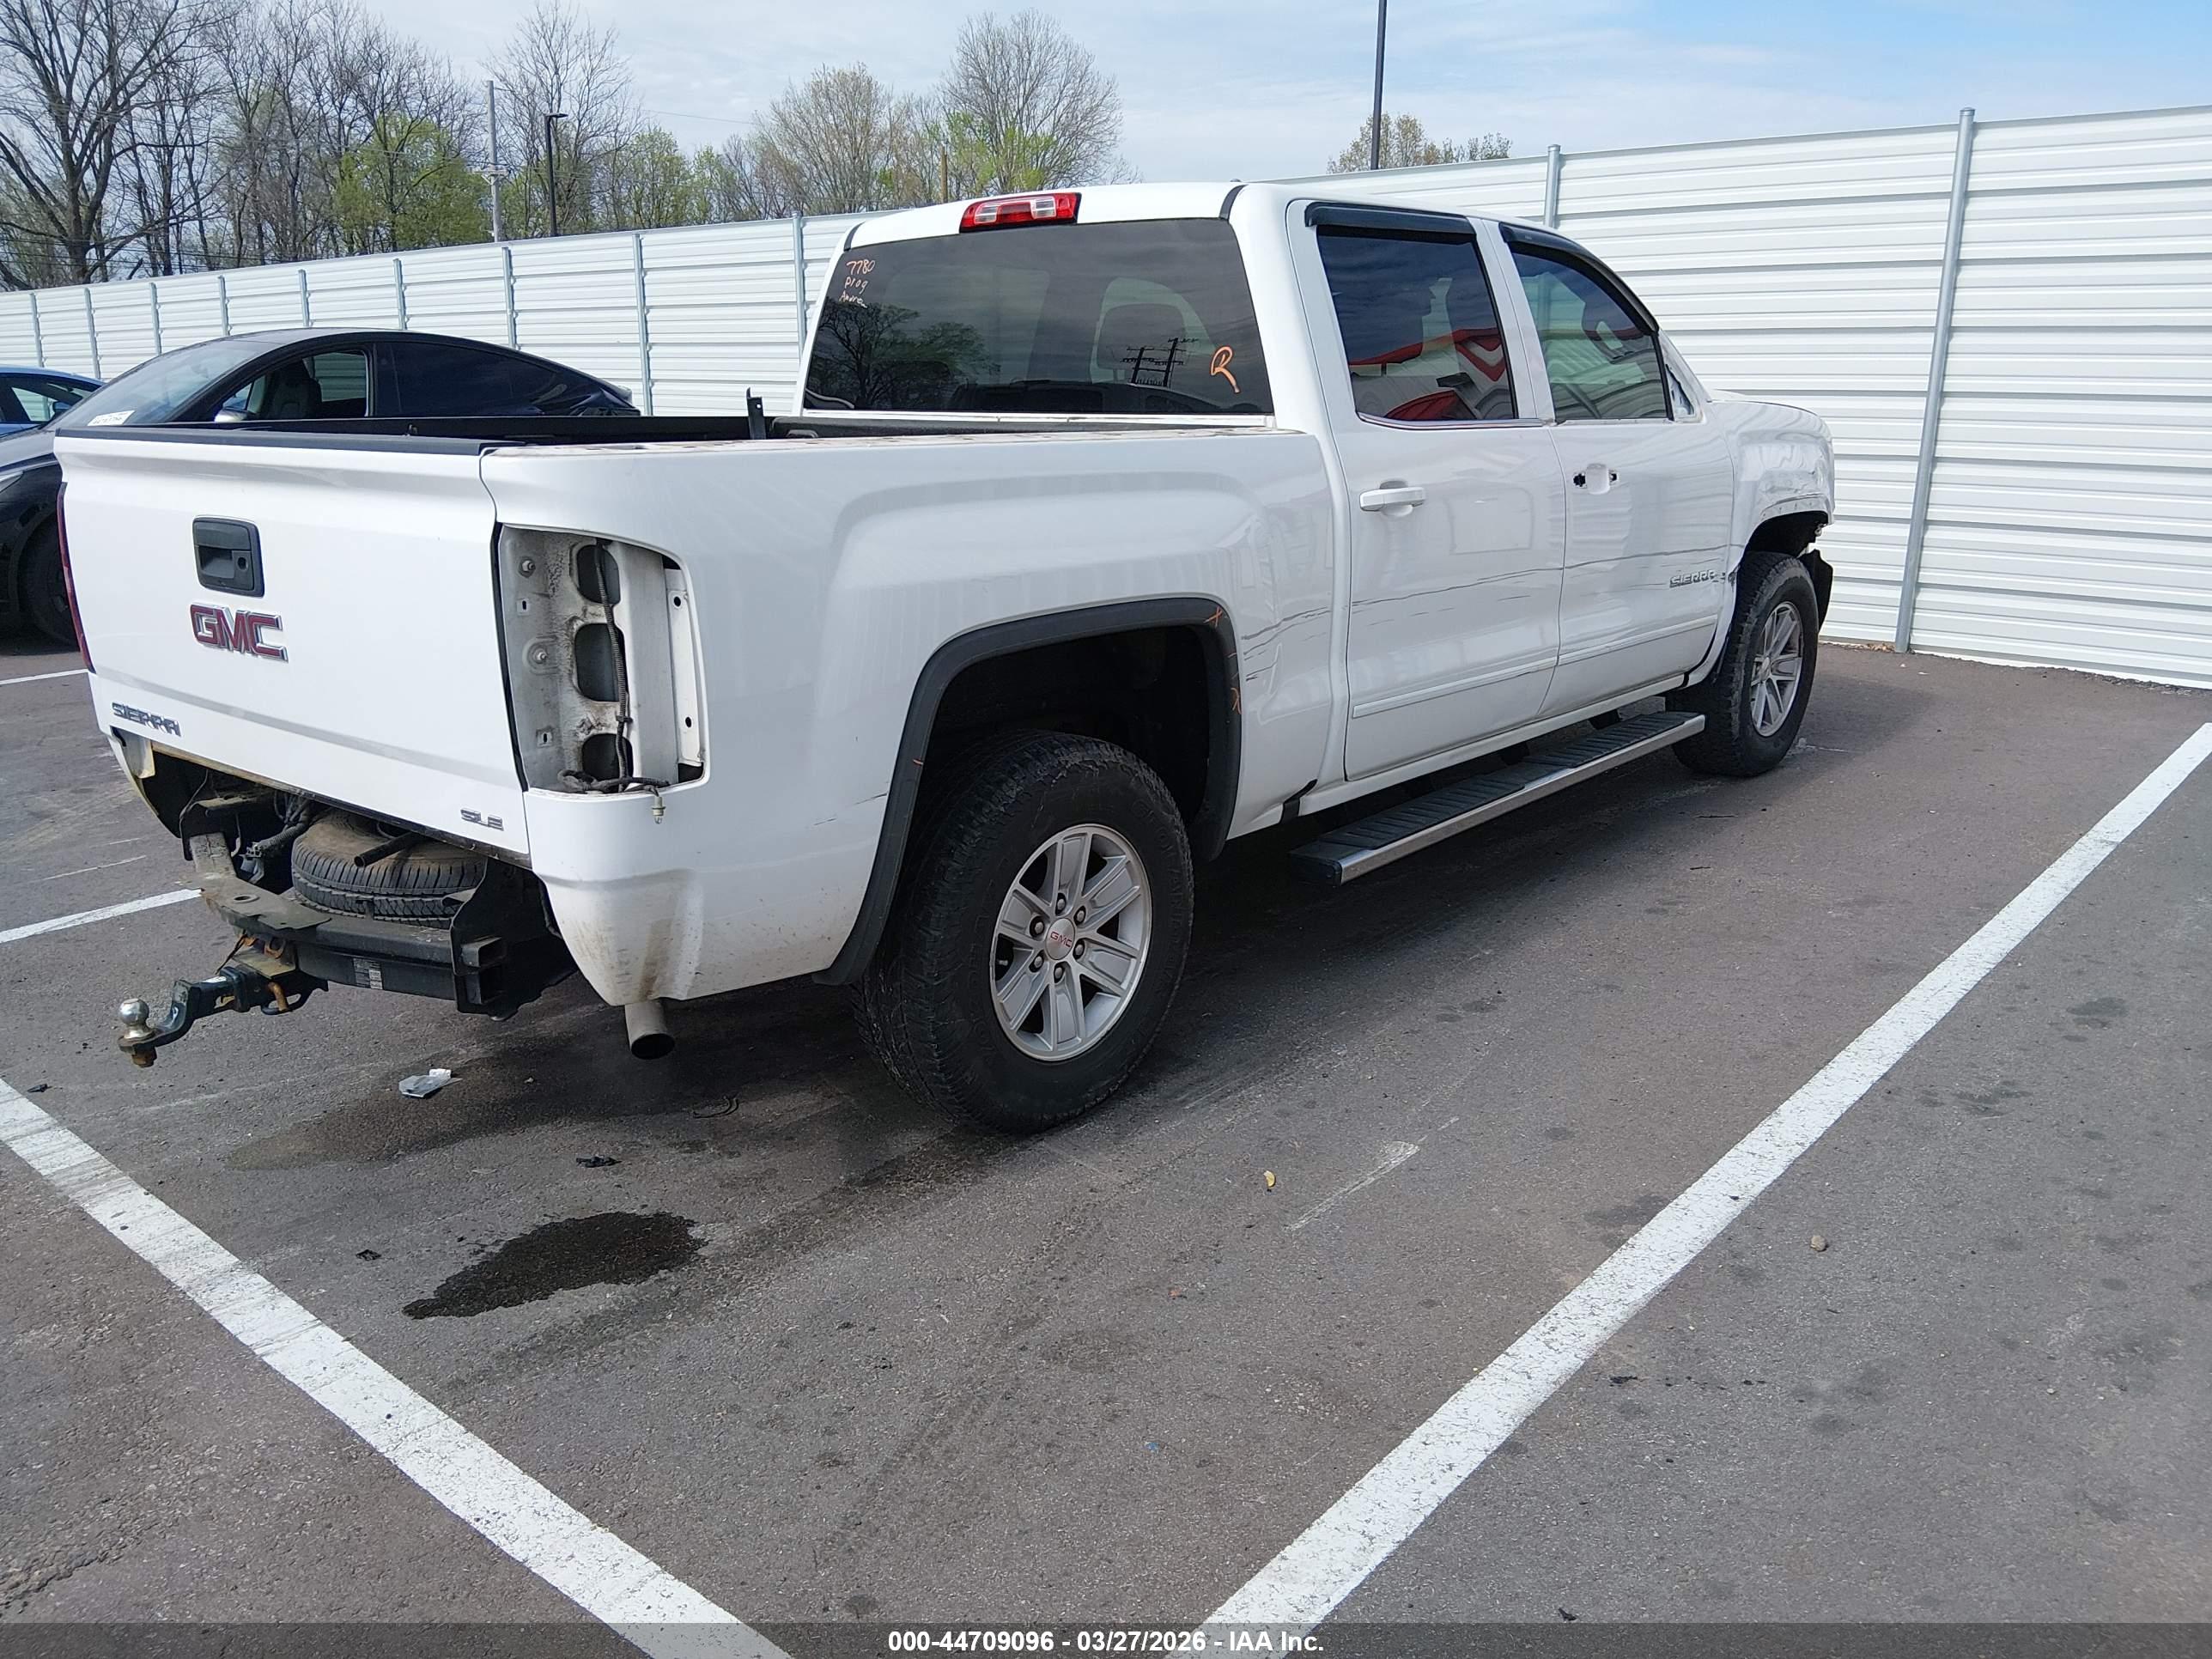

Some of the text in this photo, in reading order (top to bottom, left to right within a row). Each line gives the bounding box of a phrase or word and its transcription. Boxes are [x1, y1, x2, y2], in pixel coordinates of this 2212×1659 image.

[846, 259, 876, 276] 7780
[1210, 346, 1240, 393] R
[190, 602, 289, 664] GMC
[111, 702, 181, 737] SIERRA
[459, 808, 504, 831] SLE
[1050, 931, 1073, 948] GMC
